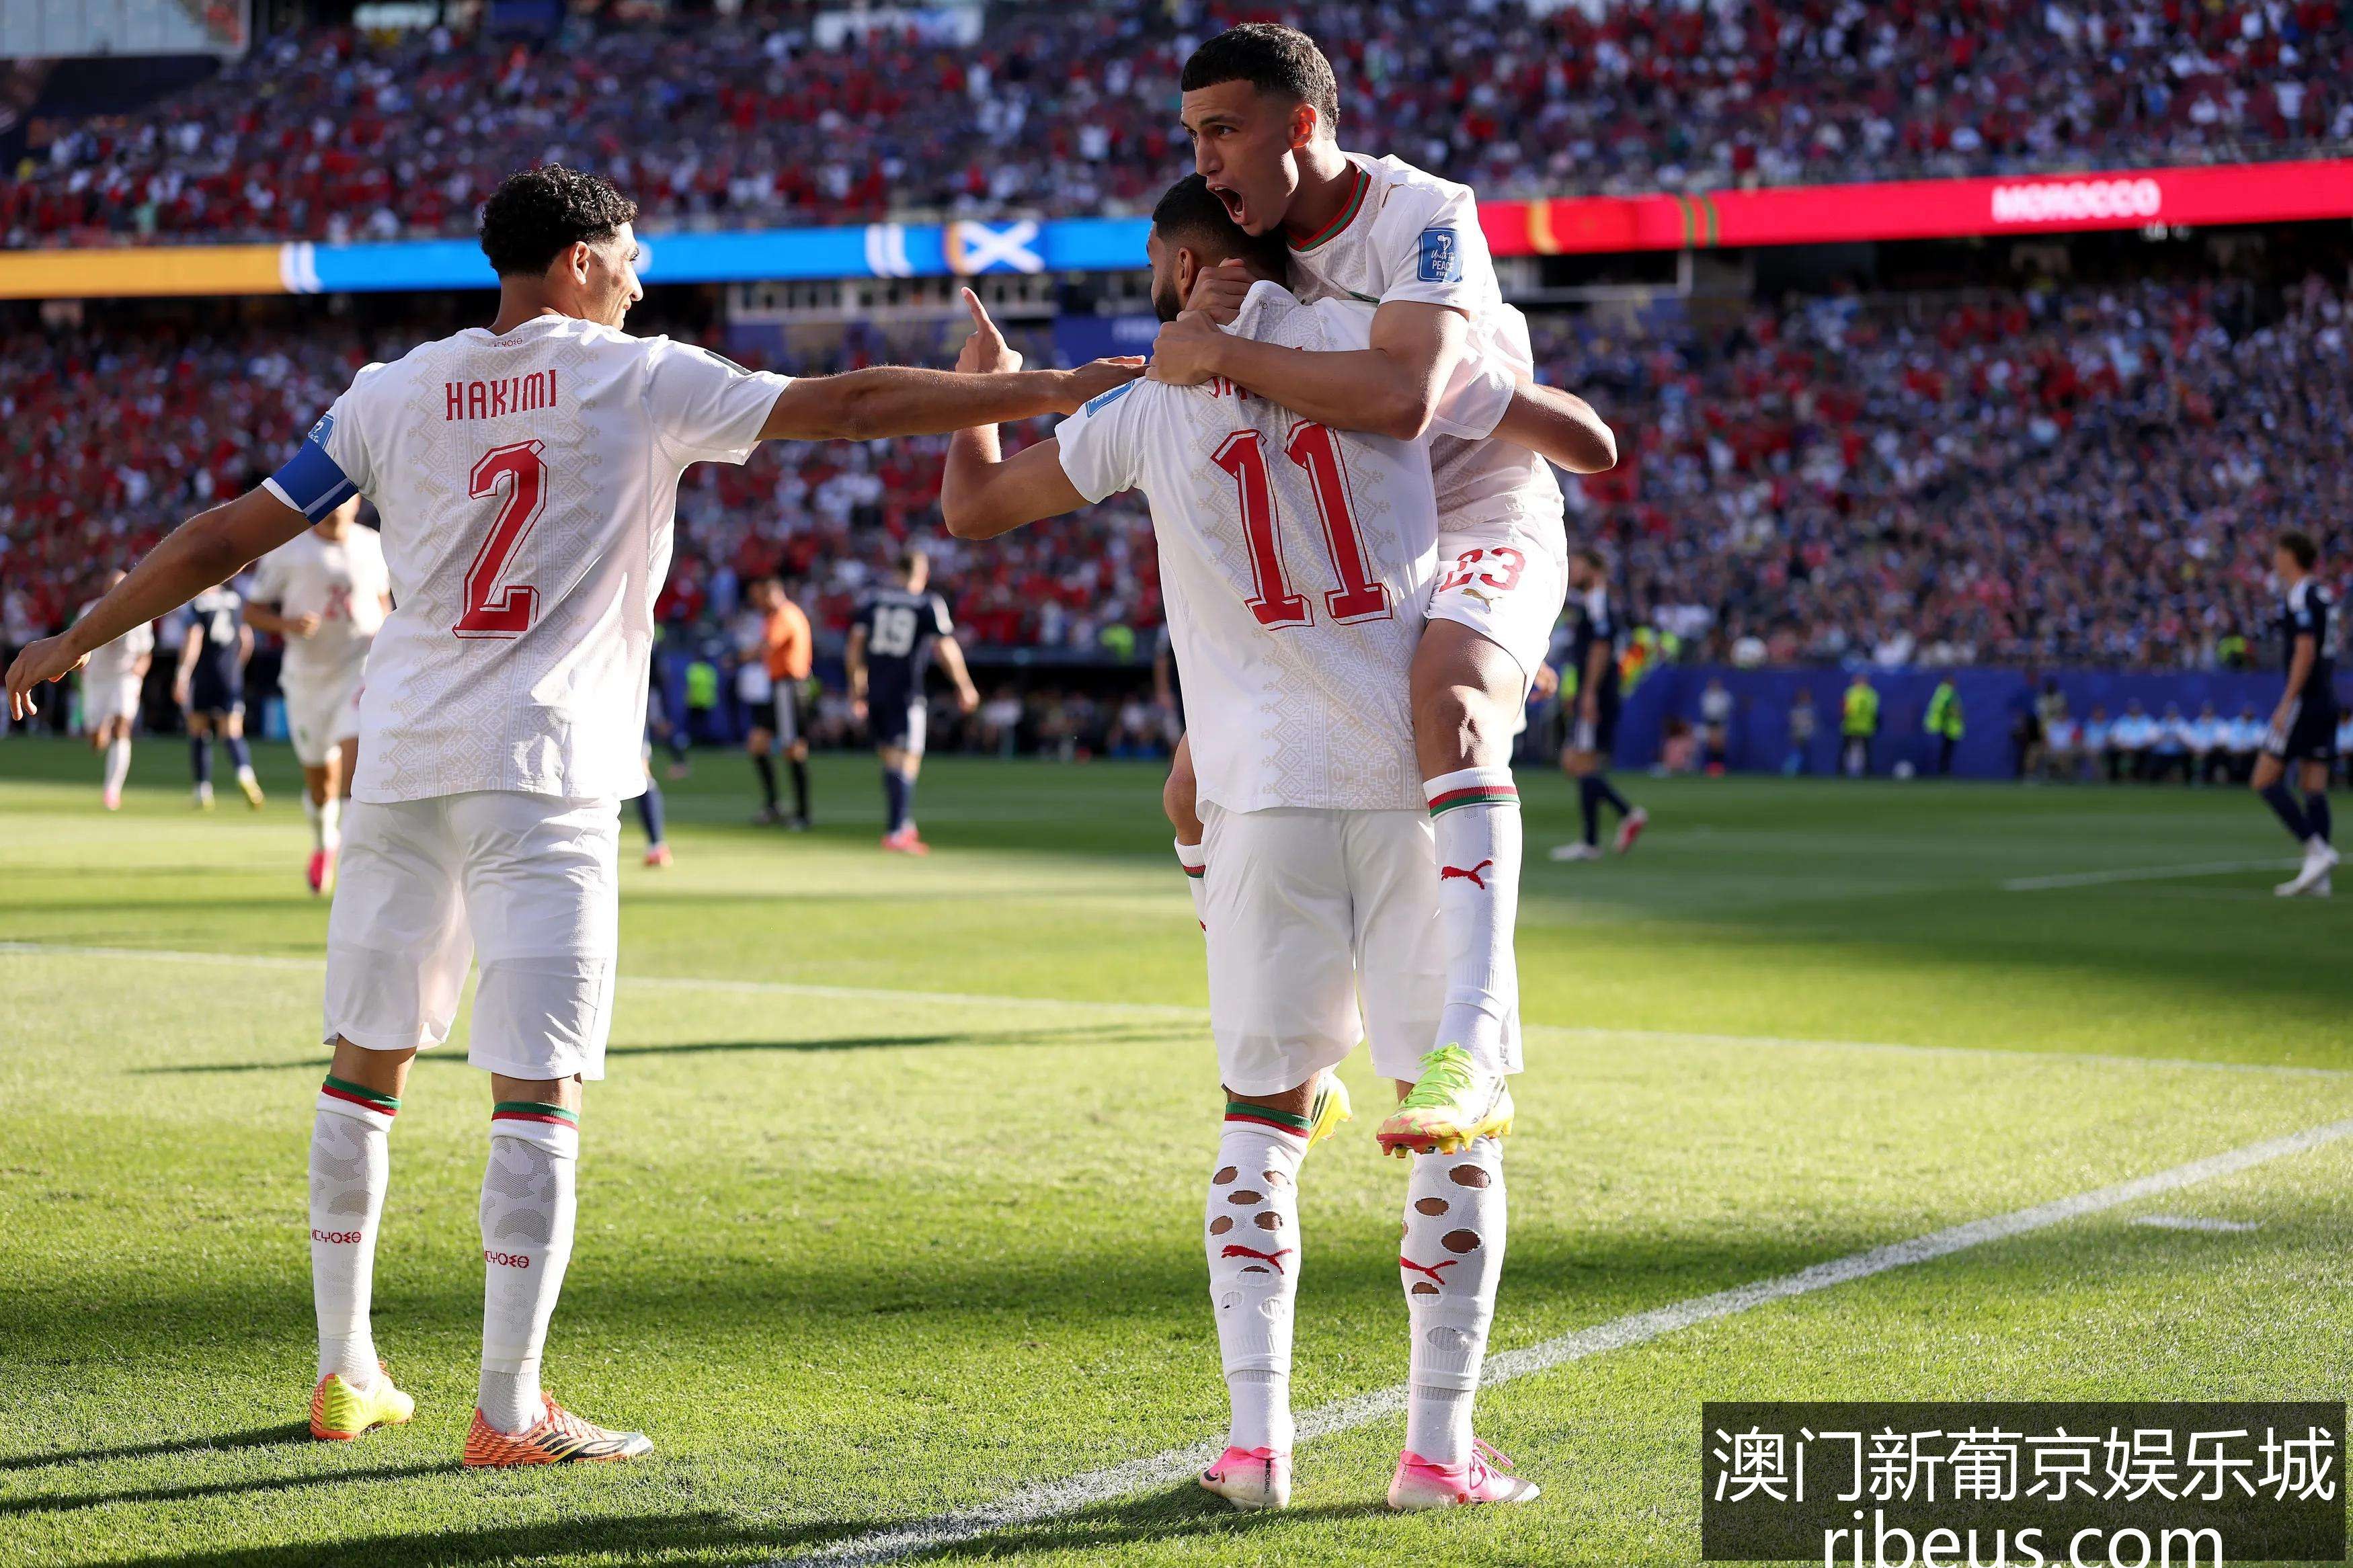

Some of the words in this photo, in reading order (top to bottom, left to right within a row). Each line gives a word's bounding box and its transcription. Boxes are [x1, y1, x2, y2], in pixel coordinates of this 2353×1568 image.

[1992, 179, 2161, 222] MOROCCO
[1432, 260, 1453, 272] PEACE
[445, 369, 557, 421] HAKIMI
[452, 439, 548, 639] 2
[1210, 419, 1394, 632] 11
[1439, 547, 1526, 593] 23
[869, 606, 918, 657] 19
